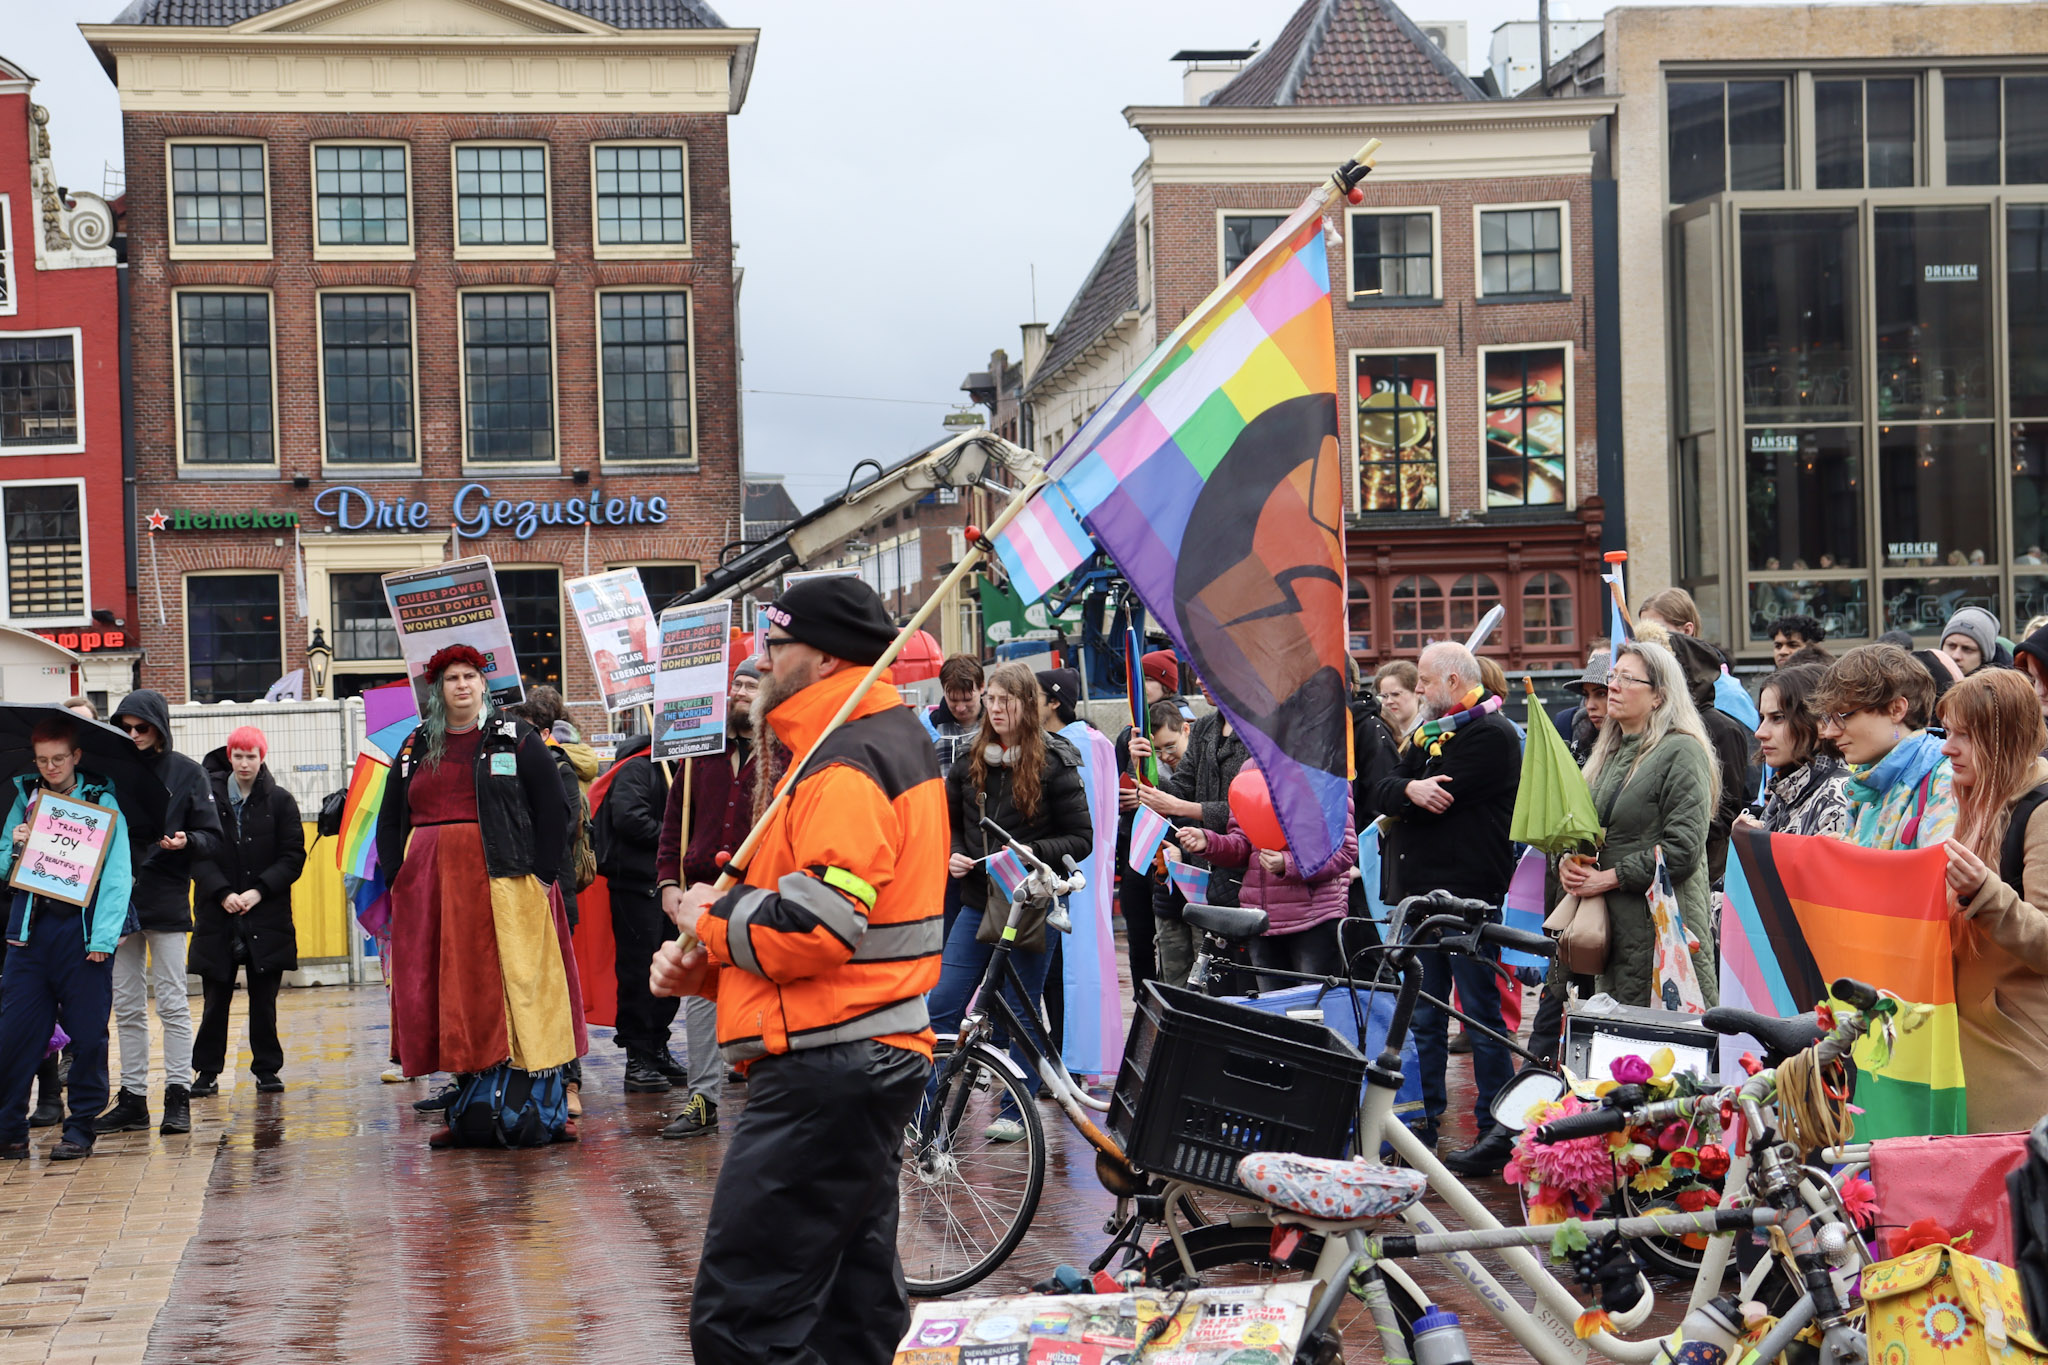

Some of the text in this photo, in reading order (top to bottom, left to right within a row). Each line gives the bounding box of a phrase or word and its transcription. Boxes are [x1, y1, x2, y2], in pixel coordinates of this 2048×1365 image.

[1925, 264, 1978, 279] DRINKEN
[1752, 436, 1798, 449] DANSEN
[314, 483, 668, 540] Drie Gezusters
[172, 509, 299, 530] Heineken
[1888, 542, 1938, 555] WERKEN
[399, 582, 484, 604] QUEER POWER
[402, 596, 489, 618] BLACK POWER
[587, 605, 641, 624] LIBERATION
[404, 609, 494, 632] WOMEN POWER
[693, 624, 720, 637] POWER
[663, 639, 720, 656] BLACK POWER
[618, 651, 643, 664] CLASS
[661, 653, 720, 670] WOMEN POWER
[610, 663, 656, 680] LIBERATION
[664, 697, 712, 711] ALL POWER TO
[664, 707, 712, 720] THE WORKING
[668, 743, 710, 755] socialisme.nu
[58, 822, 82, 834] TRANS
[51, 833, 80, 850] JOY
[45, 856, 75, 870] BEAUTIFUL
[1202, 1304, 1244, 1317] NEE
